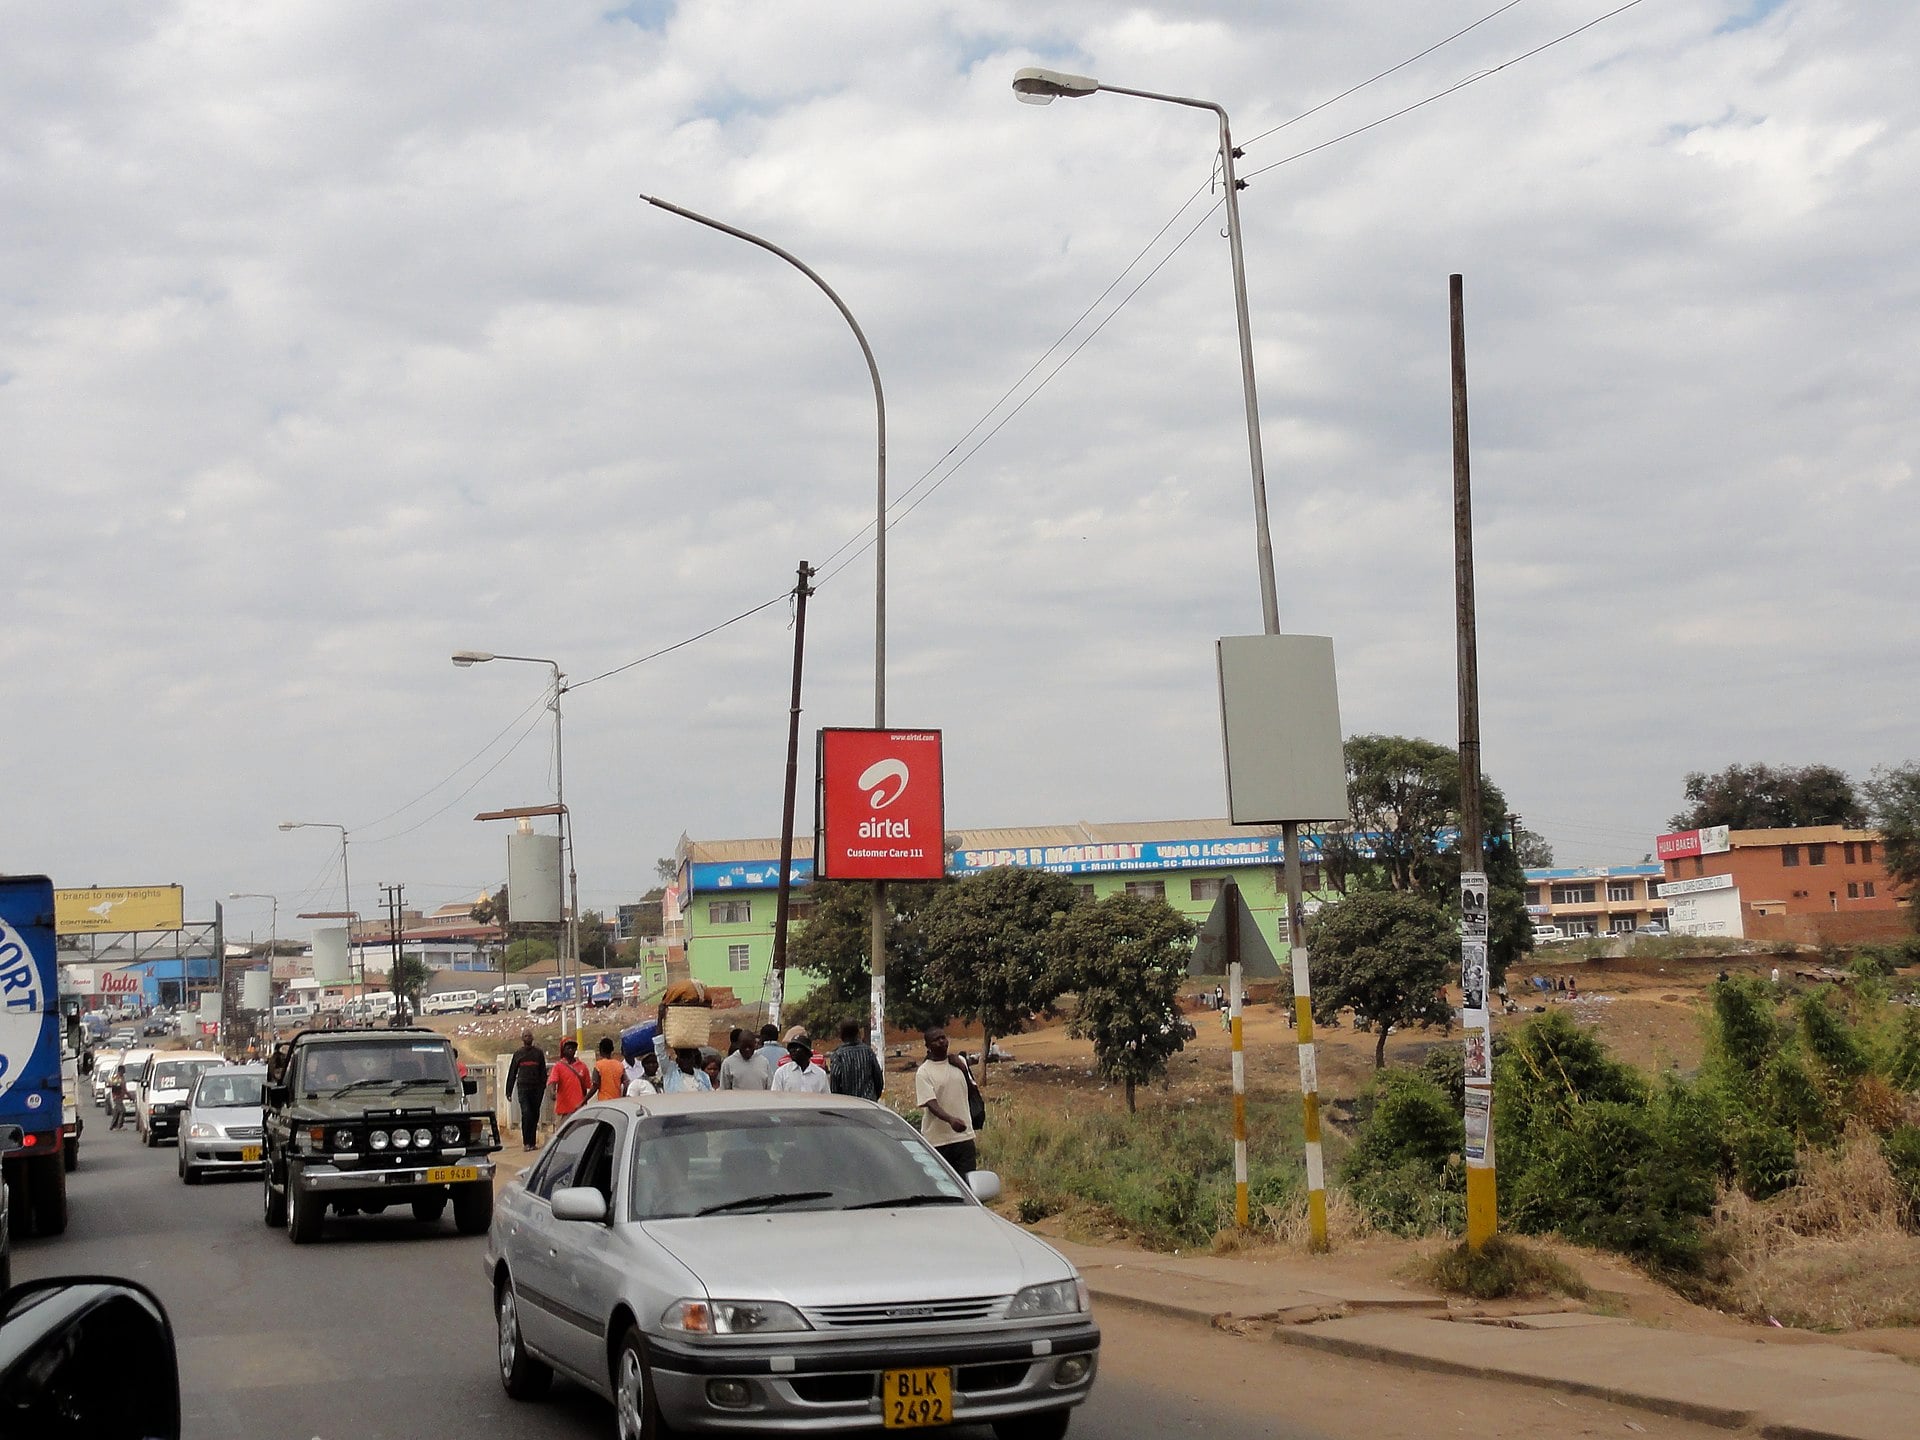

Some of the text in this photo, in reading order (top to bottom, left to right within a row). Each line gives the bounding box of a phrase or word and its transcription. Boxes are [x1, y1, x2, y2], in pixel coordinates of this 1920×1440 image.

[858, 817, 911, 838] airtel
[847, 848, 924, 858] Customer Care 111
[1676, 837, 1698, 851] BAKERY
[965, 843, 1143, 867] SUPERMARKET
[63, 891, 89, 900] brand
[93, 891, 102, 899] to
[127, 889, 161, 899] heights
[101, 971, 138, 992] Bata
[898, 1371, 938, 1397] BLK
[894, 1399, 944, 1425] 2492
